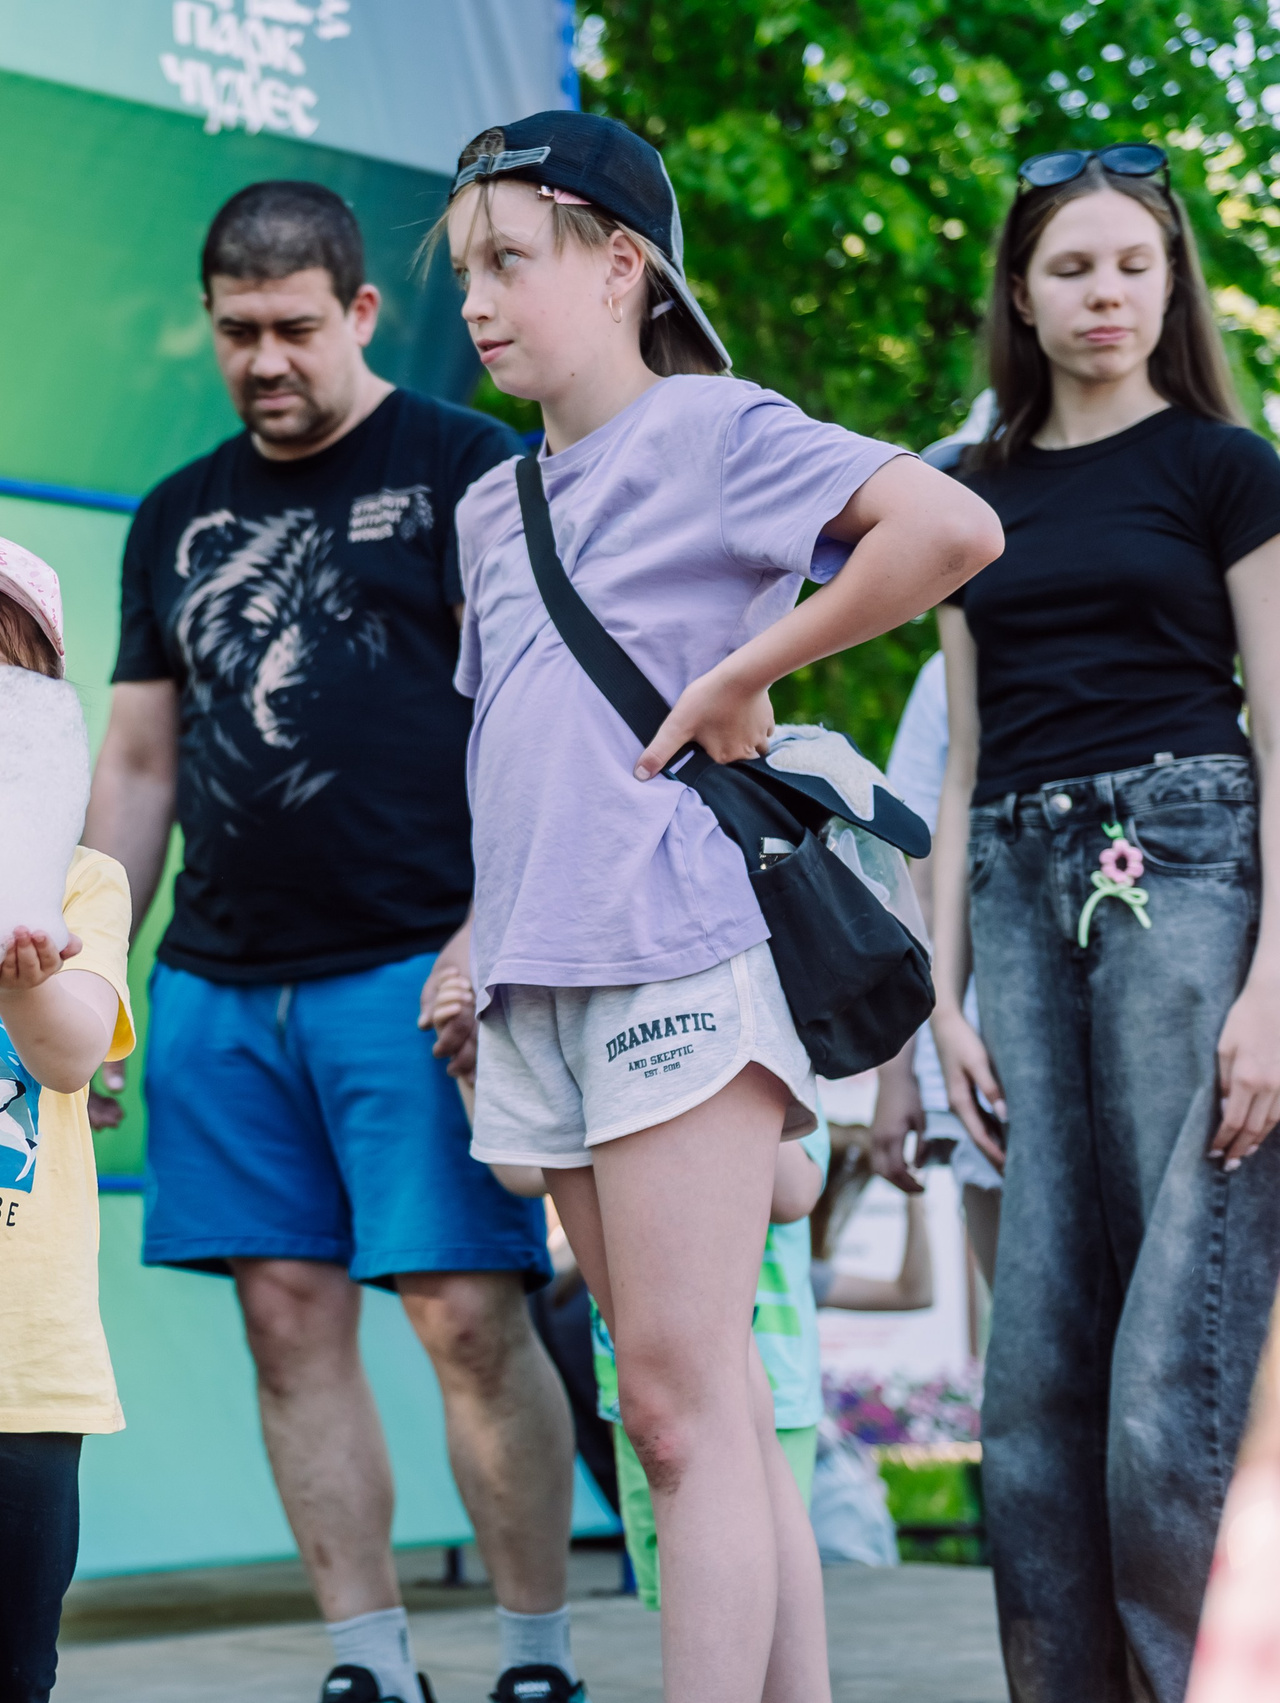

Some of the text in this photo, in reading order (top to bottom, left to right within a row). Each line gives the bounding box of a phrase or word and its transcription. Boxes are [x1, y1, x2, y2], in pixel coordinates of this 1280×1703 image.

[605, 1012, 717, 1063] DRAMATIC
[628, 1044, 694, 1072] AND SKEPTIC
